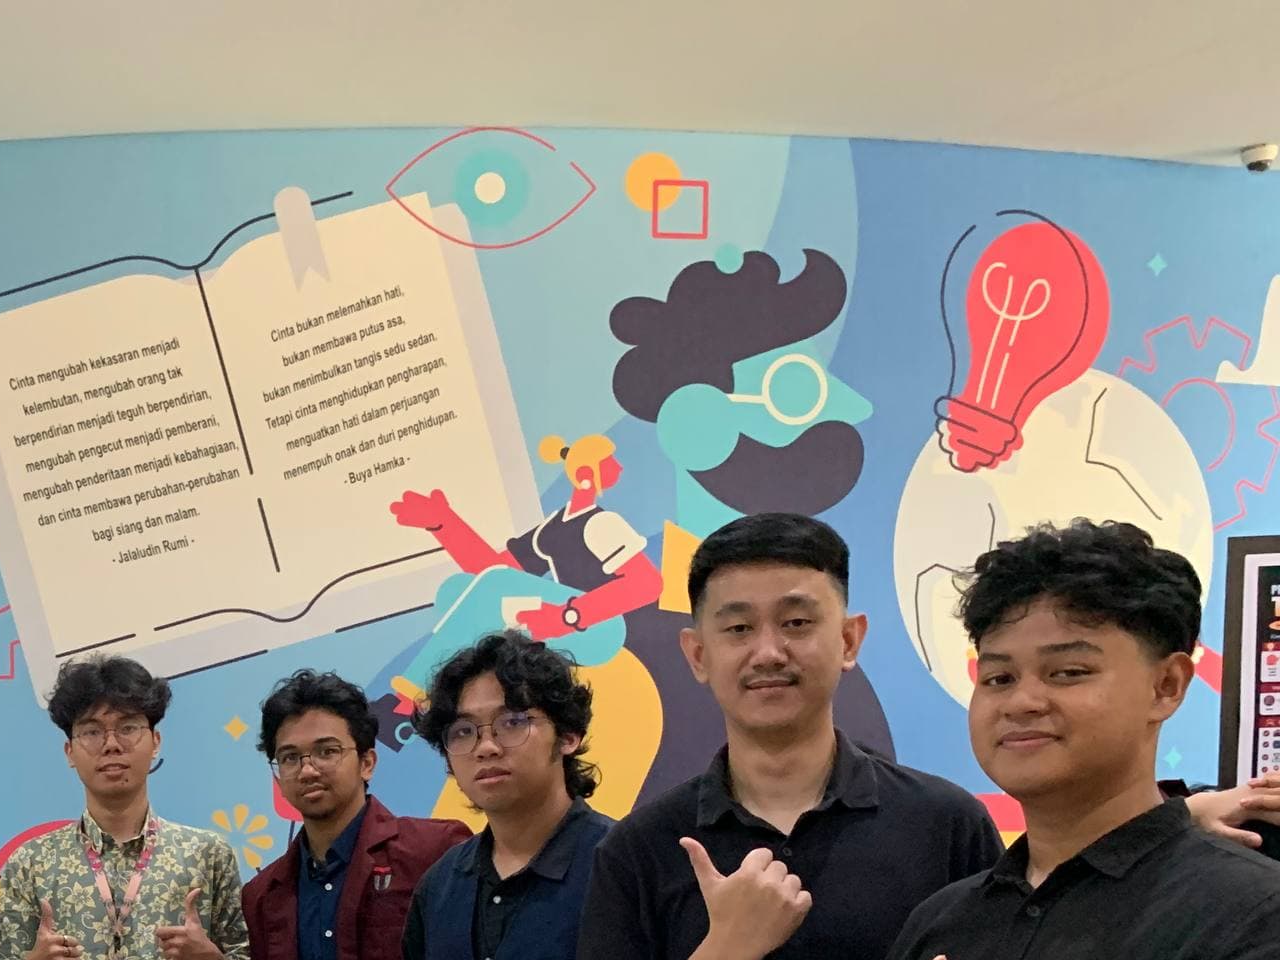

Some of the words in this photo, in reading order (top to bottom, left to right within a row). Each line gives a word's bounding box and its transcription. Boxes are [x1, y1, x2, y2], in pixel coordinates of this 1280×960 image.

[270, 325, 296, 343] Cinta
[295, 315, 326, 334] bukan
[325, 293, 384, 323] melemahkan
[8, 375, 37, 392] Cinta
[36, 359, 89, 385] mengubah
[88, 349, 141, 371] kekasaran
[140, 336, 181, 358] menjadi
[281, 348, 311, 368] bukan
[311, 331, 358, 357] membawa
[358, 321, 386, 342] putus
[83, 376, 136, 401] mengubah
[136, 371, 167, 388] orang
[166, 365, 184, 380] tak
[262, 384, 292, 404] bukan
[292, 362, 353, 393] menimbulkan
[352, 350, 383, 370] tangis
[383, 341, 407, 359] sedu
[12, 423, 76, 448] berpendirian
[75, 409, 117, 432] menjadi
[115, 403, 146, 423] teguh
[264, 409, 294, 430] Tetapi
[294, 403, 318, 420] cinta
[318, 378, 386, 412] menghidupkan
[285, 422, 342, 452] menguatkan
[341, 413, 361, 431] hati
[360, 405, 389, 424] dalam
[389, 386, 441, 416] perjuangan
[24, 449, 78, 473] mengubah
[77, 437, 125, 463] pengecut
[123, 426, 165, 449] menjadi
[283, 452, 334, 481] menempuh
[334, 443, 358, 462] onak
[358, 438, 377, 453] dan
[377, 428, 397, 446] duri
[347, 468, 373, 485] Buya
[372, 455, 406, 476] Hamka
[22, 478, 75, 503] mengubah
[74, 466, 134, 493] penderitaan
[133, 453, 174, 475] menjadi
[37, 513, 57, 527] dan
[57, 506, 83, 523] cinta
[82, 494, 134, 516] membawa
[133, 468, 241, 507] perubahan-perubahan
[91, 524, 115, 542] bagi
[115, 520, 144, 536] siang
[144, 515, 164, 529] dan
[117, 543, 163, 564] Jalaludin
[161, 535, 190, 553] Rumi
